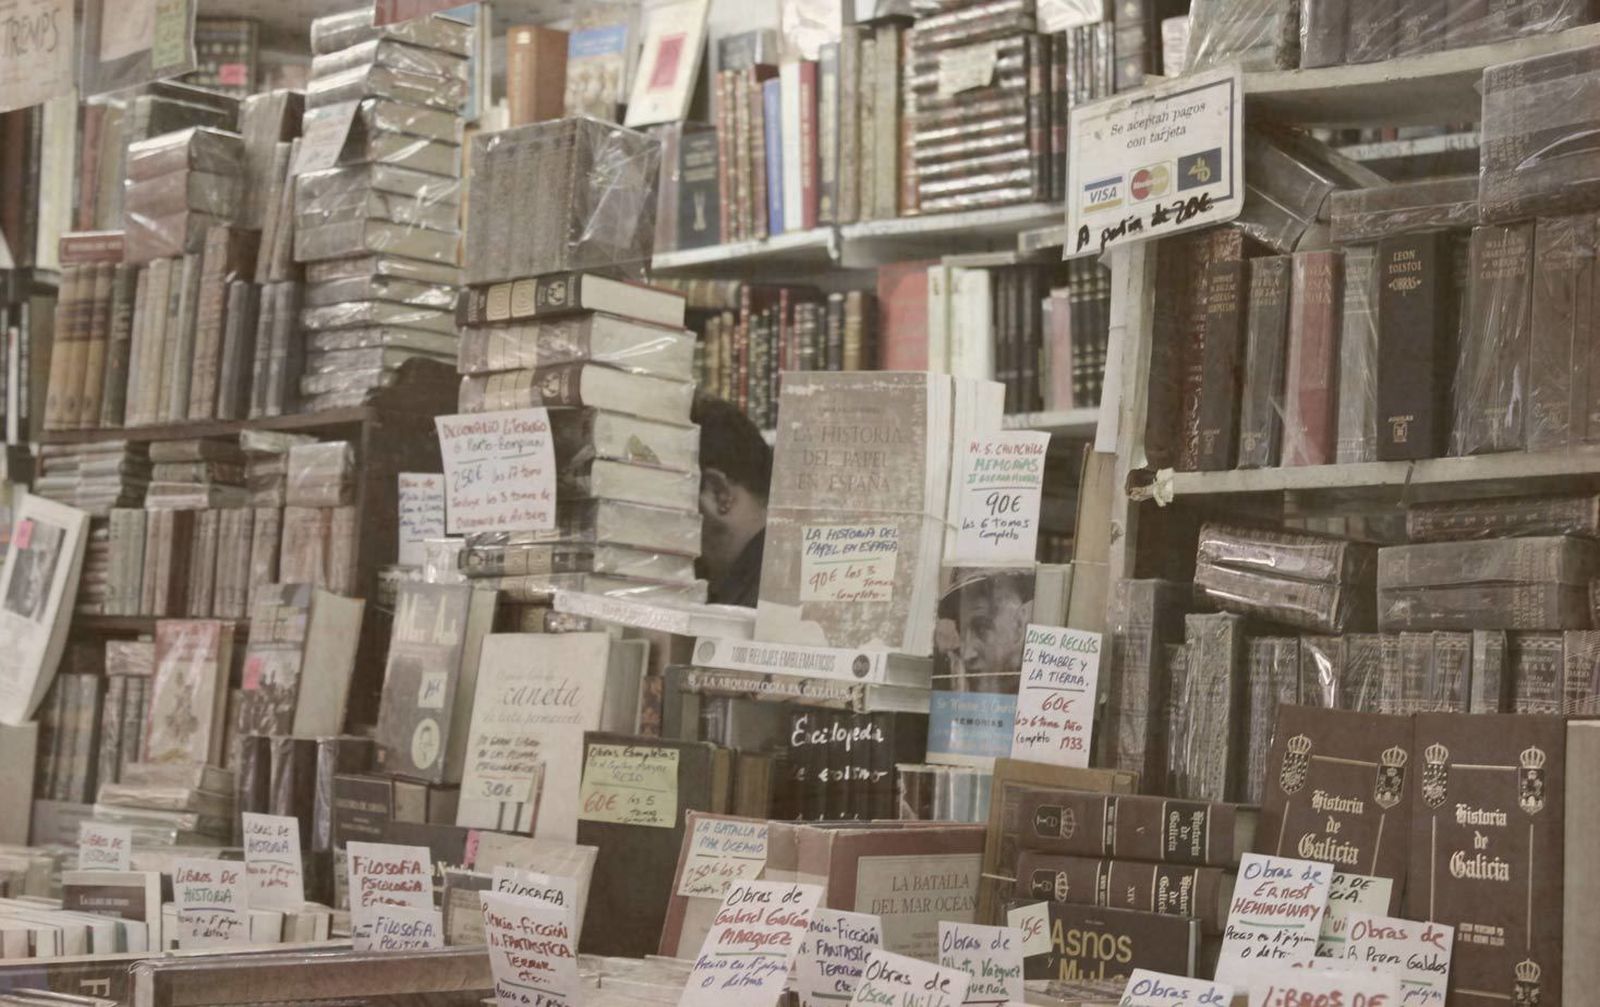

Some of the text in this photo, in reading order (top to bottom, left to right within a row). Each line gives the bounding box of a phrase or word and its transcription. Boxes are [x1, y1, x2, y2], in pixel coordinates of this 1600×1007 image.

[1111, 102, 1205, 136] Se aceptan pagos
[1127, 126, 1186, 148] con tarjeta
[1090, 187, 1116, 203] VISA
[1077, 225, 1090, 252] A
[1393, 250, 1414, 261] LEON
[822, 426, 904, 443] HISTORIA
[803, 451, 888, 467] DEL PAPEL
[985, 491, 1022, 516] 90€
[806, 528, 898, 540] LA HISTORIA DEL
[806, 541, 840, 557] PAPEL
[843, 544, 858, 553] EN
[1024, 649, 1033, 662] EL
[1039, 651, 1078, 670] HOMBRE
[703, 676, 718, 688] LA
[1028, 670, 1043, 681] LA
[1042, 692, 1076, 714] 60€
[1312, 789, 1364, 815] Historia
[1325, 815, 1342, 834] de
[1455, 803, 1508, 828] Historia
[1298, 832, 1360, 866] Galicia
[1474, 830, 1488, 850] de
[221, 870, 238, 884] DE
[1244, 860, 1293, 881] Obras
[1301, 864, 1324, 884] de
[1450, 851, 1510, 882] Galicia
[892, 873, 969, 892] LA BATALLA
[1253, 881, 1314, 899] Ernest
[727, 886, 770, 906] Obras
[782, 885, 802, 903] de
[871, 895, 977, 915] DEL MAR OCEAN
[714, 908, 764, 925] Gabriel
[1231, 899, 1320, 922] HEMINGWAY
[942, 926, 981, 953] Obras
[991, 930, 1010, 949] de
[1051, 918, 1132, 964] Asnos
[1351, 921, 1408, 941] Obras
[1420, 926, 1446, 950] de
[1406, 953, 1449, 975] Galdos
[866, 960, 951, 993] Obras de
[1132, 980, 1190, 999] Obras
[1198, 987, 1224, 1007] de
